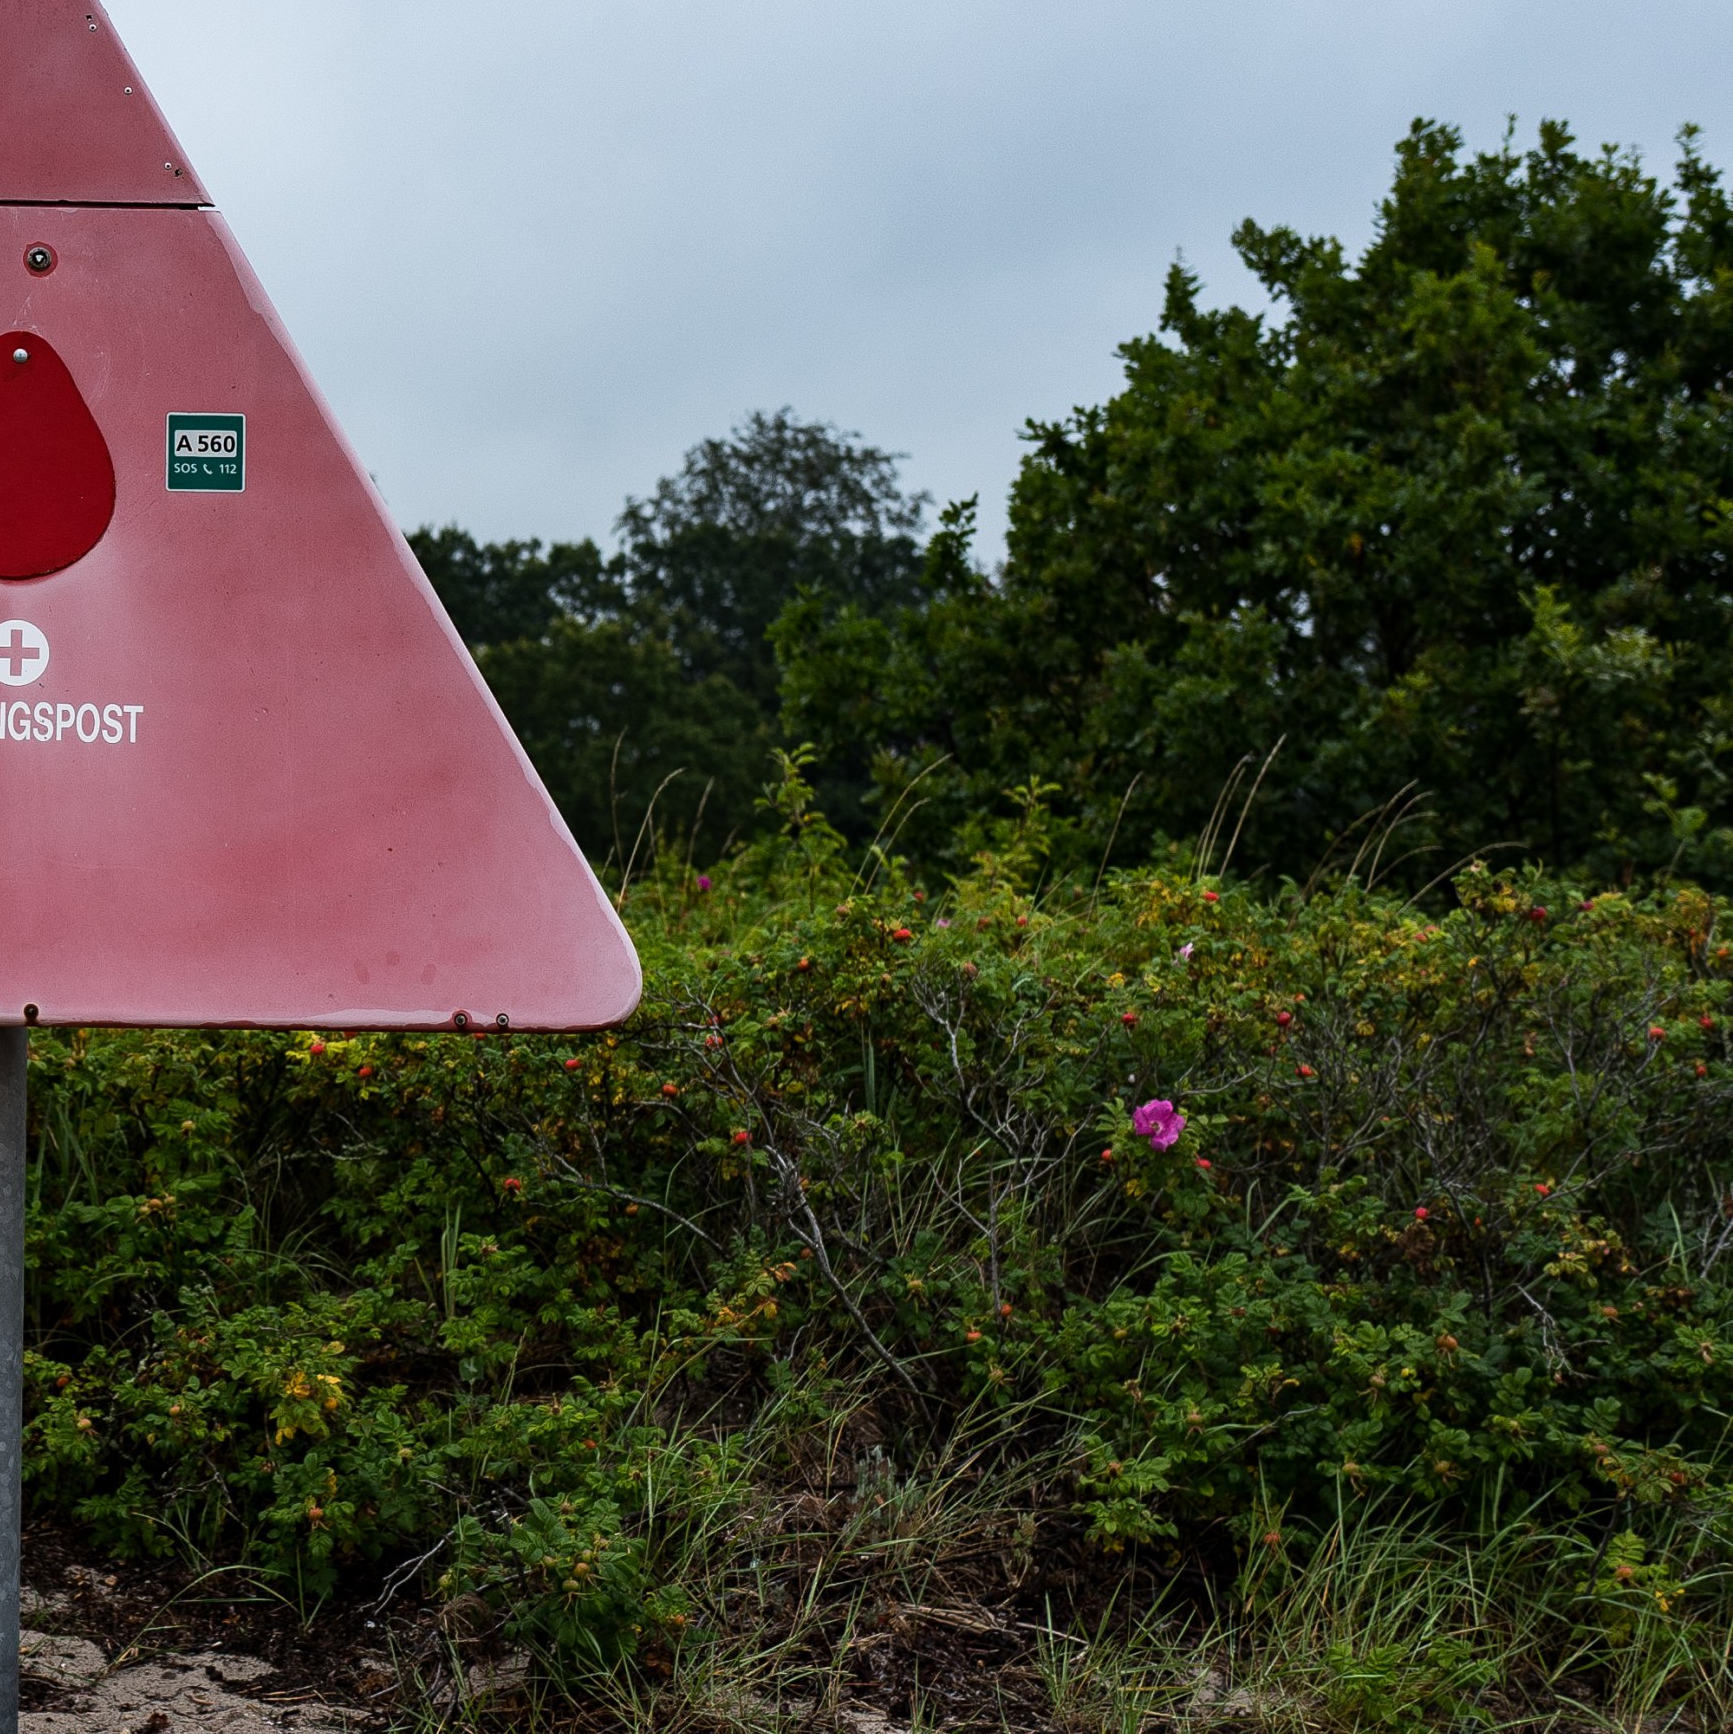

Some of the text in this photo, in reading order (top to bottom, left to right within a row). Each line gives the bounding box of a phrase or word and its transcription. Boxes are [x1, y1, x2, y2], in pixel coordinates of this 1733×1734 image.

[176, 434, 236, 453] A 560
[174, 463, 237, 474] SOS 112
